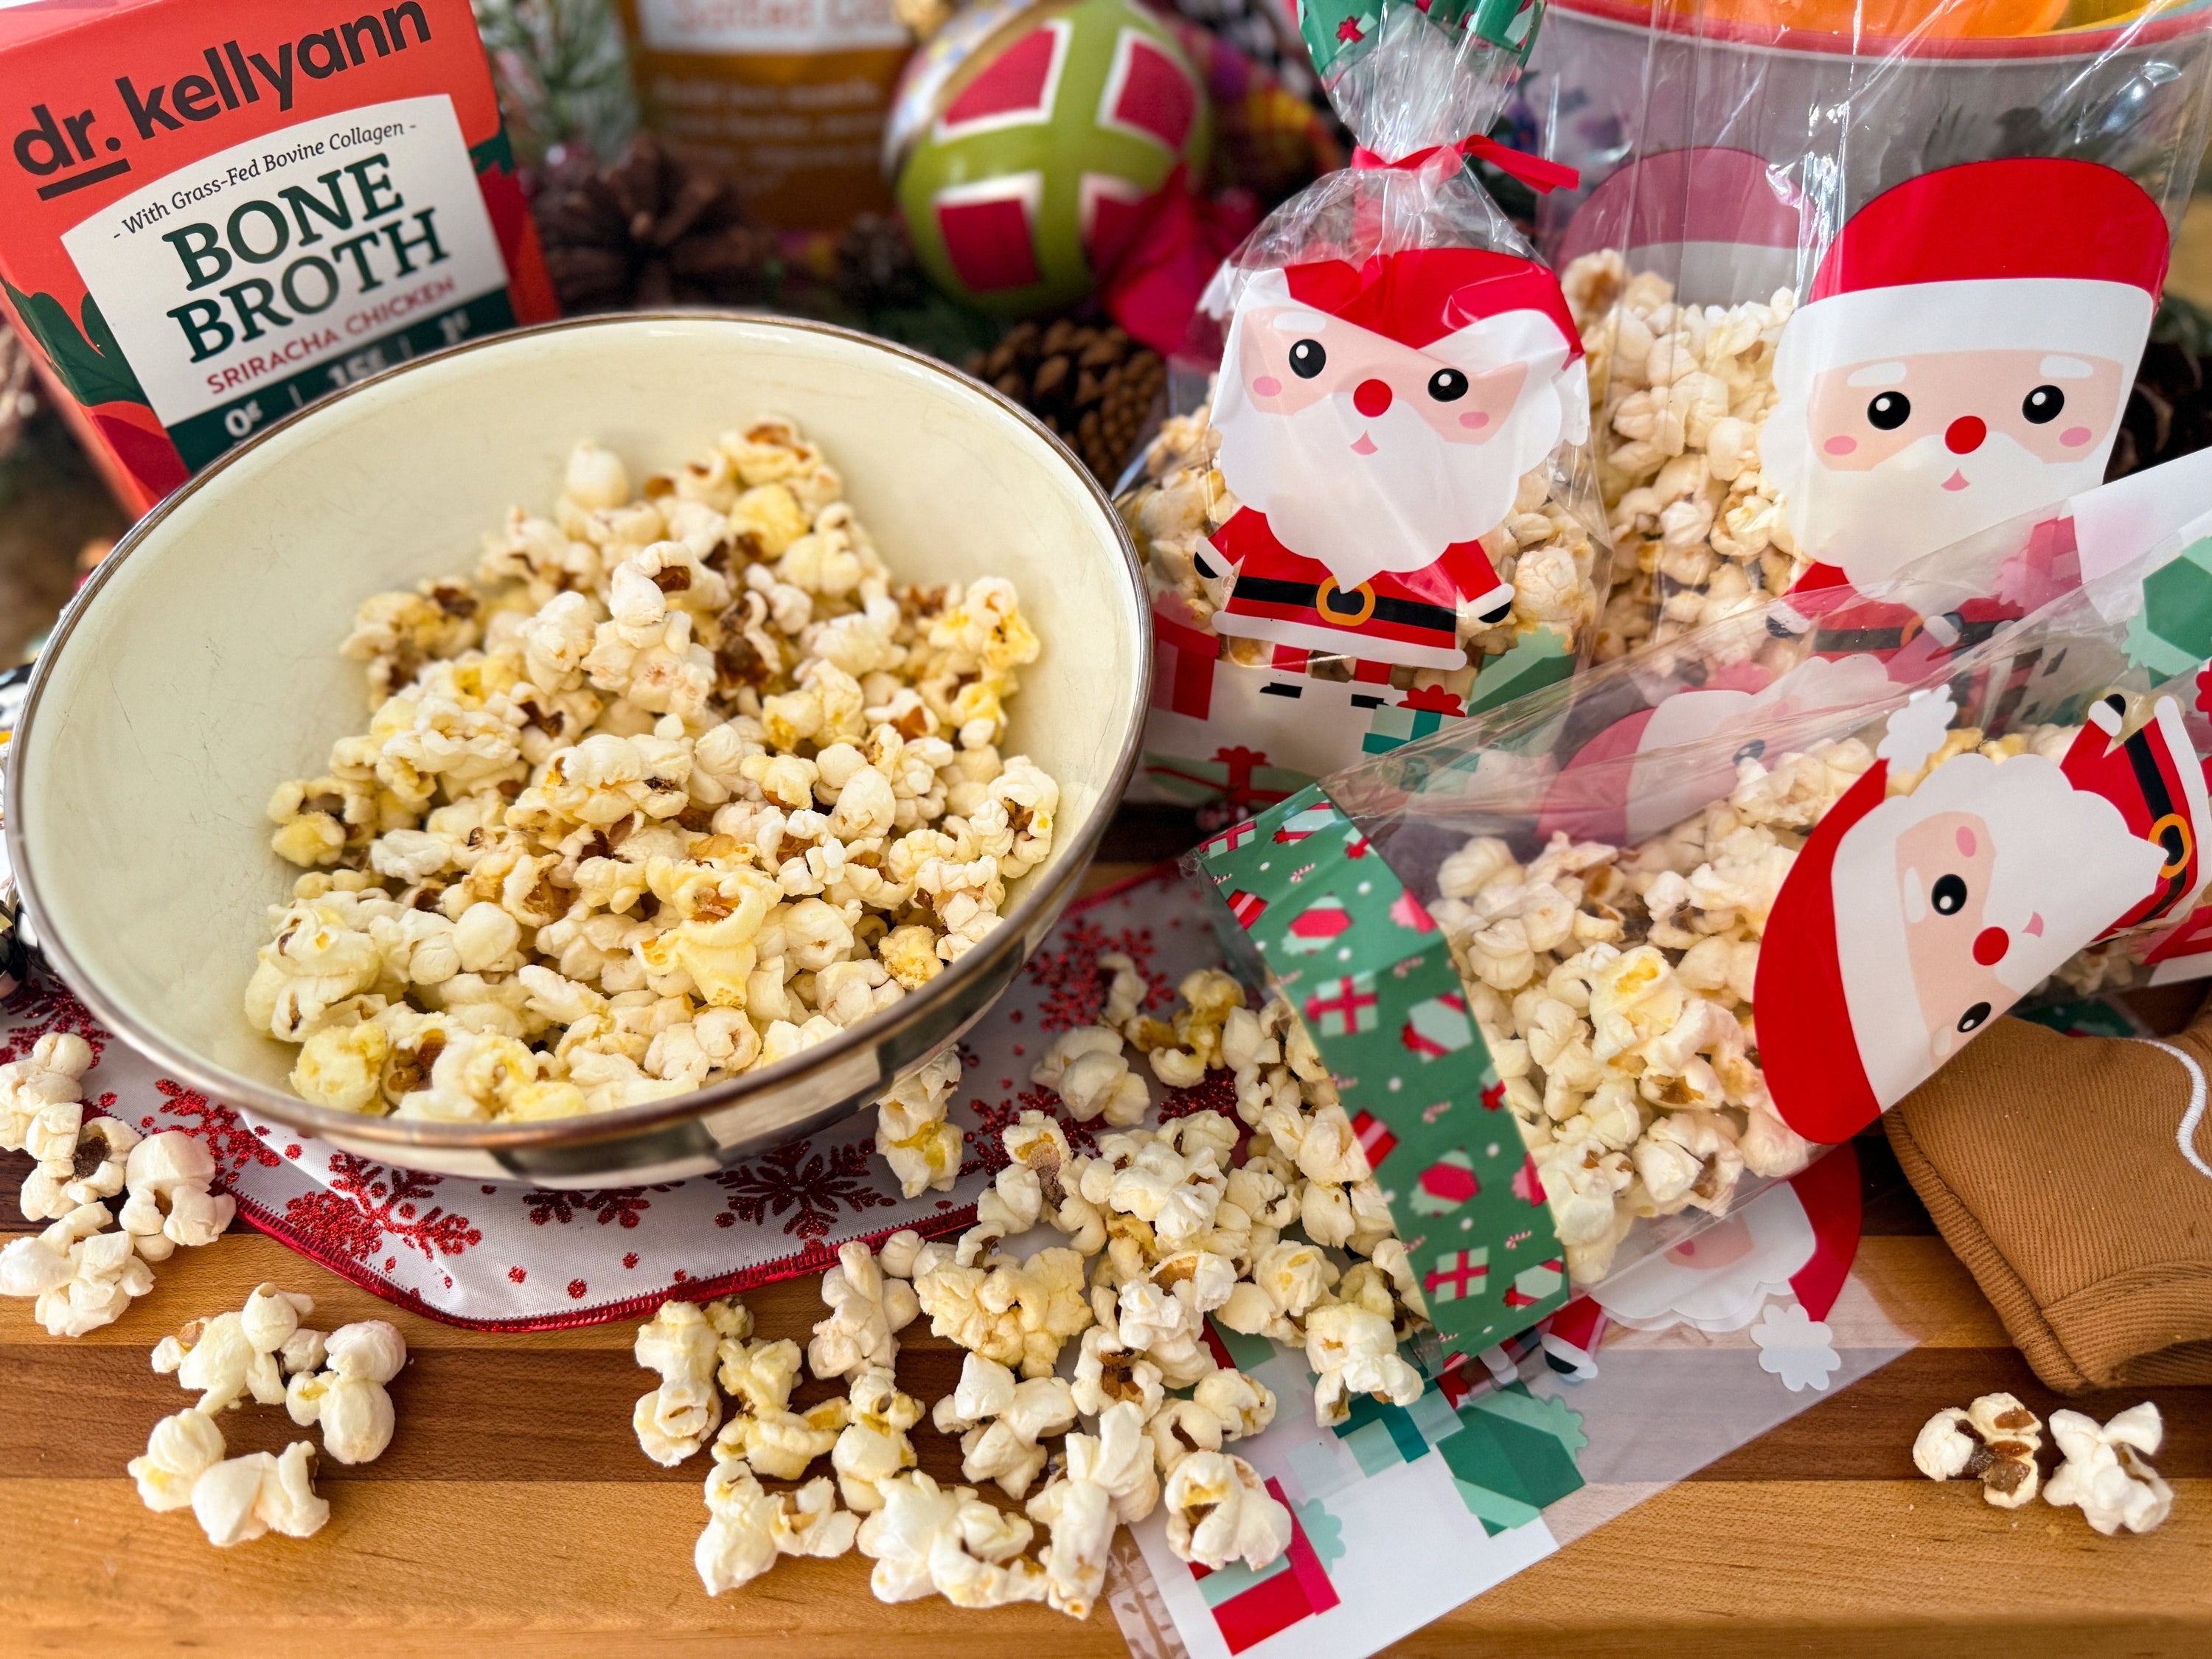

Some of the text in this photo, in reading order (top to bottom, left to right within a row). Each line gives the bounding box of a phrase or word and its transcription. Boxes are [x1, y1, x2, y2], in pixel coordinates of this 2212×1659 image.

[13, 1, 432, 199] dr. kellyann
[122, 201, 171, 234] With
[171, 157, 261, 210] Grass-Fed
[262, 141, 325, 173] Bovine
[329, 120, 404, 150] Collagen
[161, 153, 405, 291] BONE
[167, 206, 451, 364] BROTH
[206, 276, 456, 394] SRIRACHA CHICKEN
